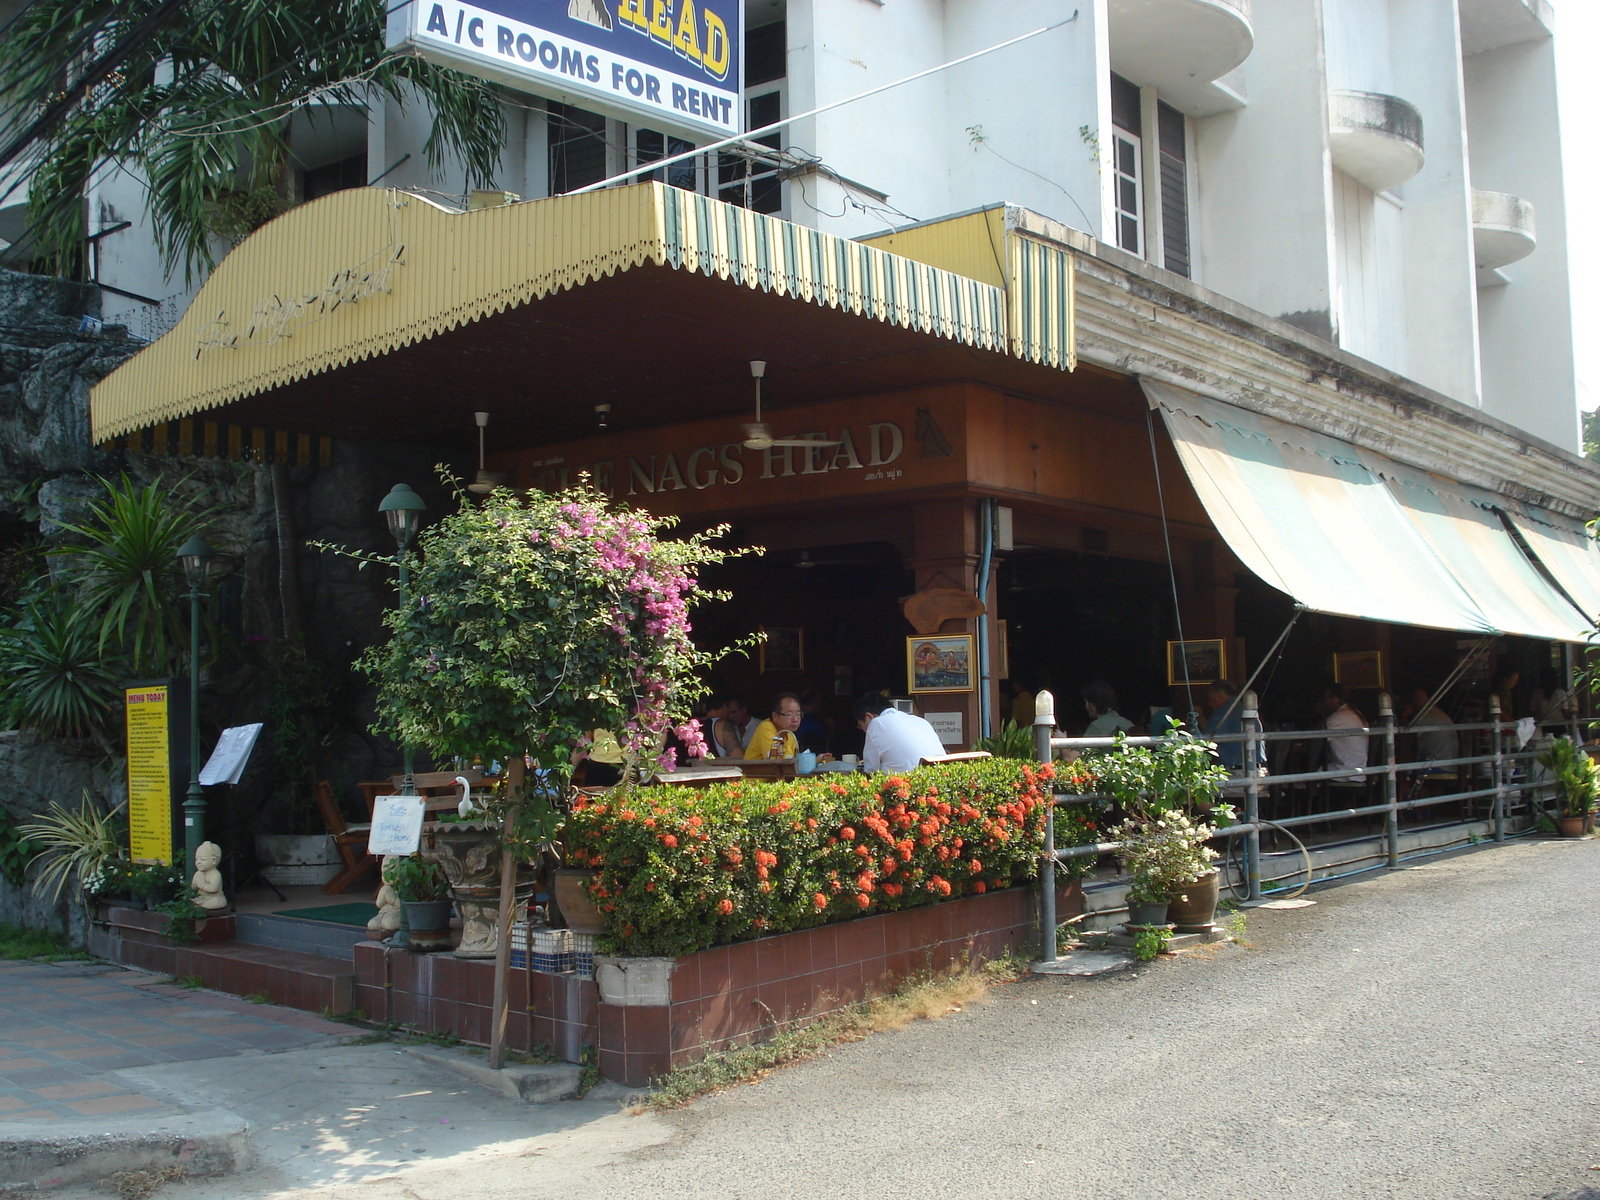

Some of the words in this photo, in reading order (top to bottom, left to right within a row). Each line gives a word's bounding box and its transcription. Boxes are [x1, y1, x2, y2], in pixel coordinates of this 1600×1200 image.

[426, 3, 484, 48] A/C
[497, 25, 601, 83] ROOMS
[611, 61, 662, 105] FOR
[672, 83, 732, 125] RENT
[627, 442, 745, 495] NAGS
[759, 421, 905, 480] HEAD
[128, 694, 145, 704] MENU
[146, 693, 165, 702] TODAY
